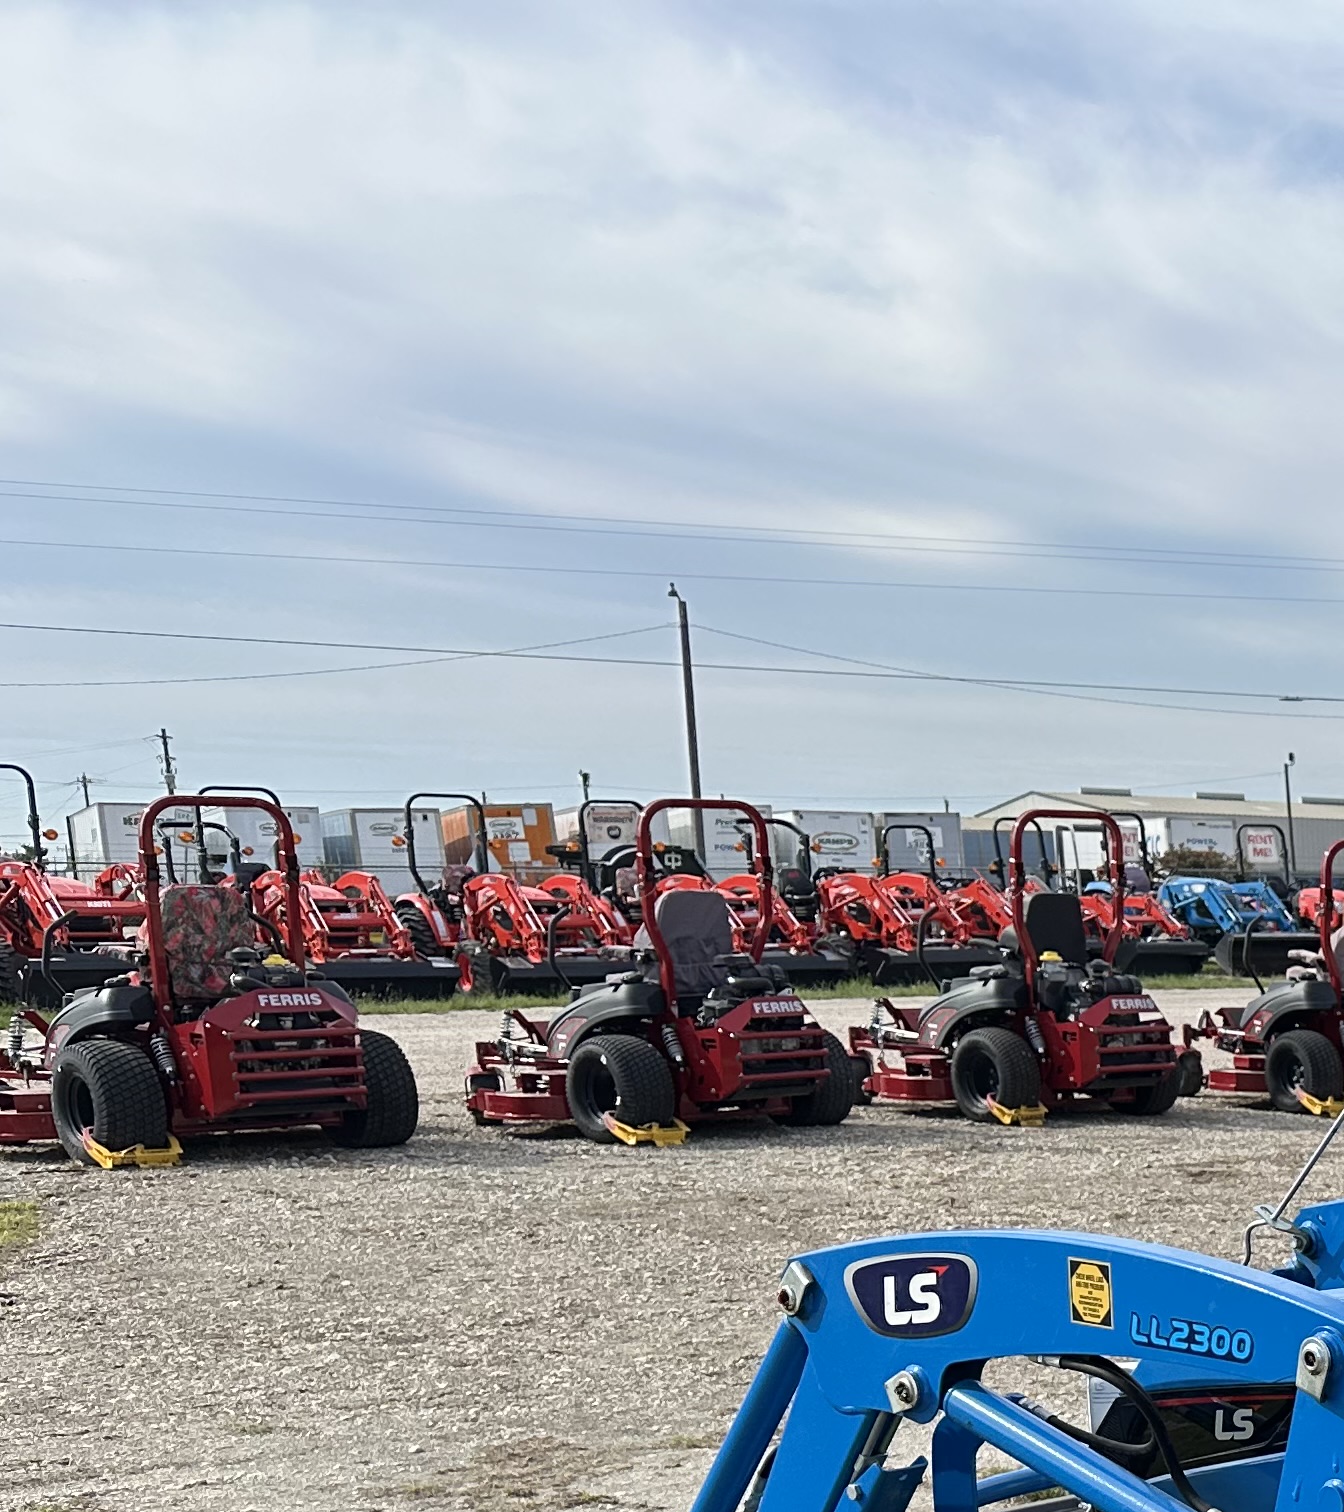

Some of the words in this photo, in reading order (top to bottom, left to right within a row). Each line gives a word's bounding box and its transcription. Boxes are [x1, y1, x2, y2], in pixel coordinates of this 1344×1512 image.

[257, 993, 323, 1007] FERRIS
[752, 1000, 803, 1014] FERRIS
[1111, 997, 1155, 1010] FERRIS
[883, 1272, 941, 1326] LS
[1131, 1312, 1254, 1363] LL2300
[1214, 1408, 1255, 1441] LS
